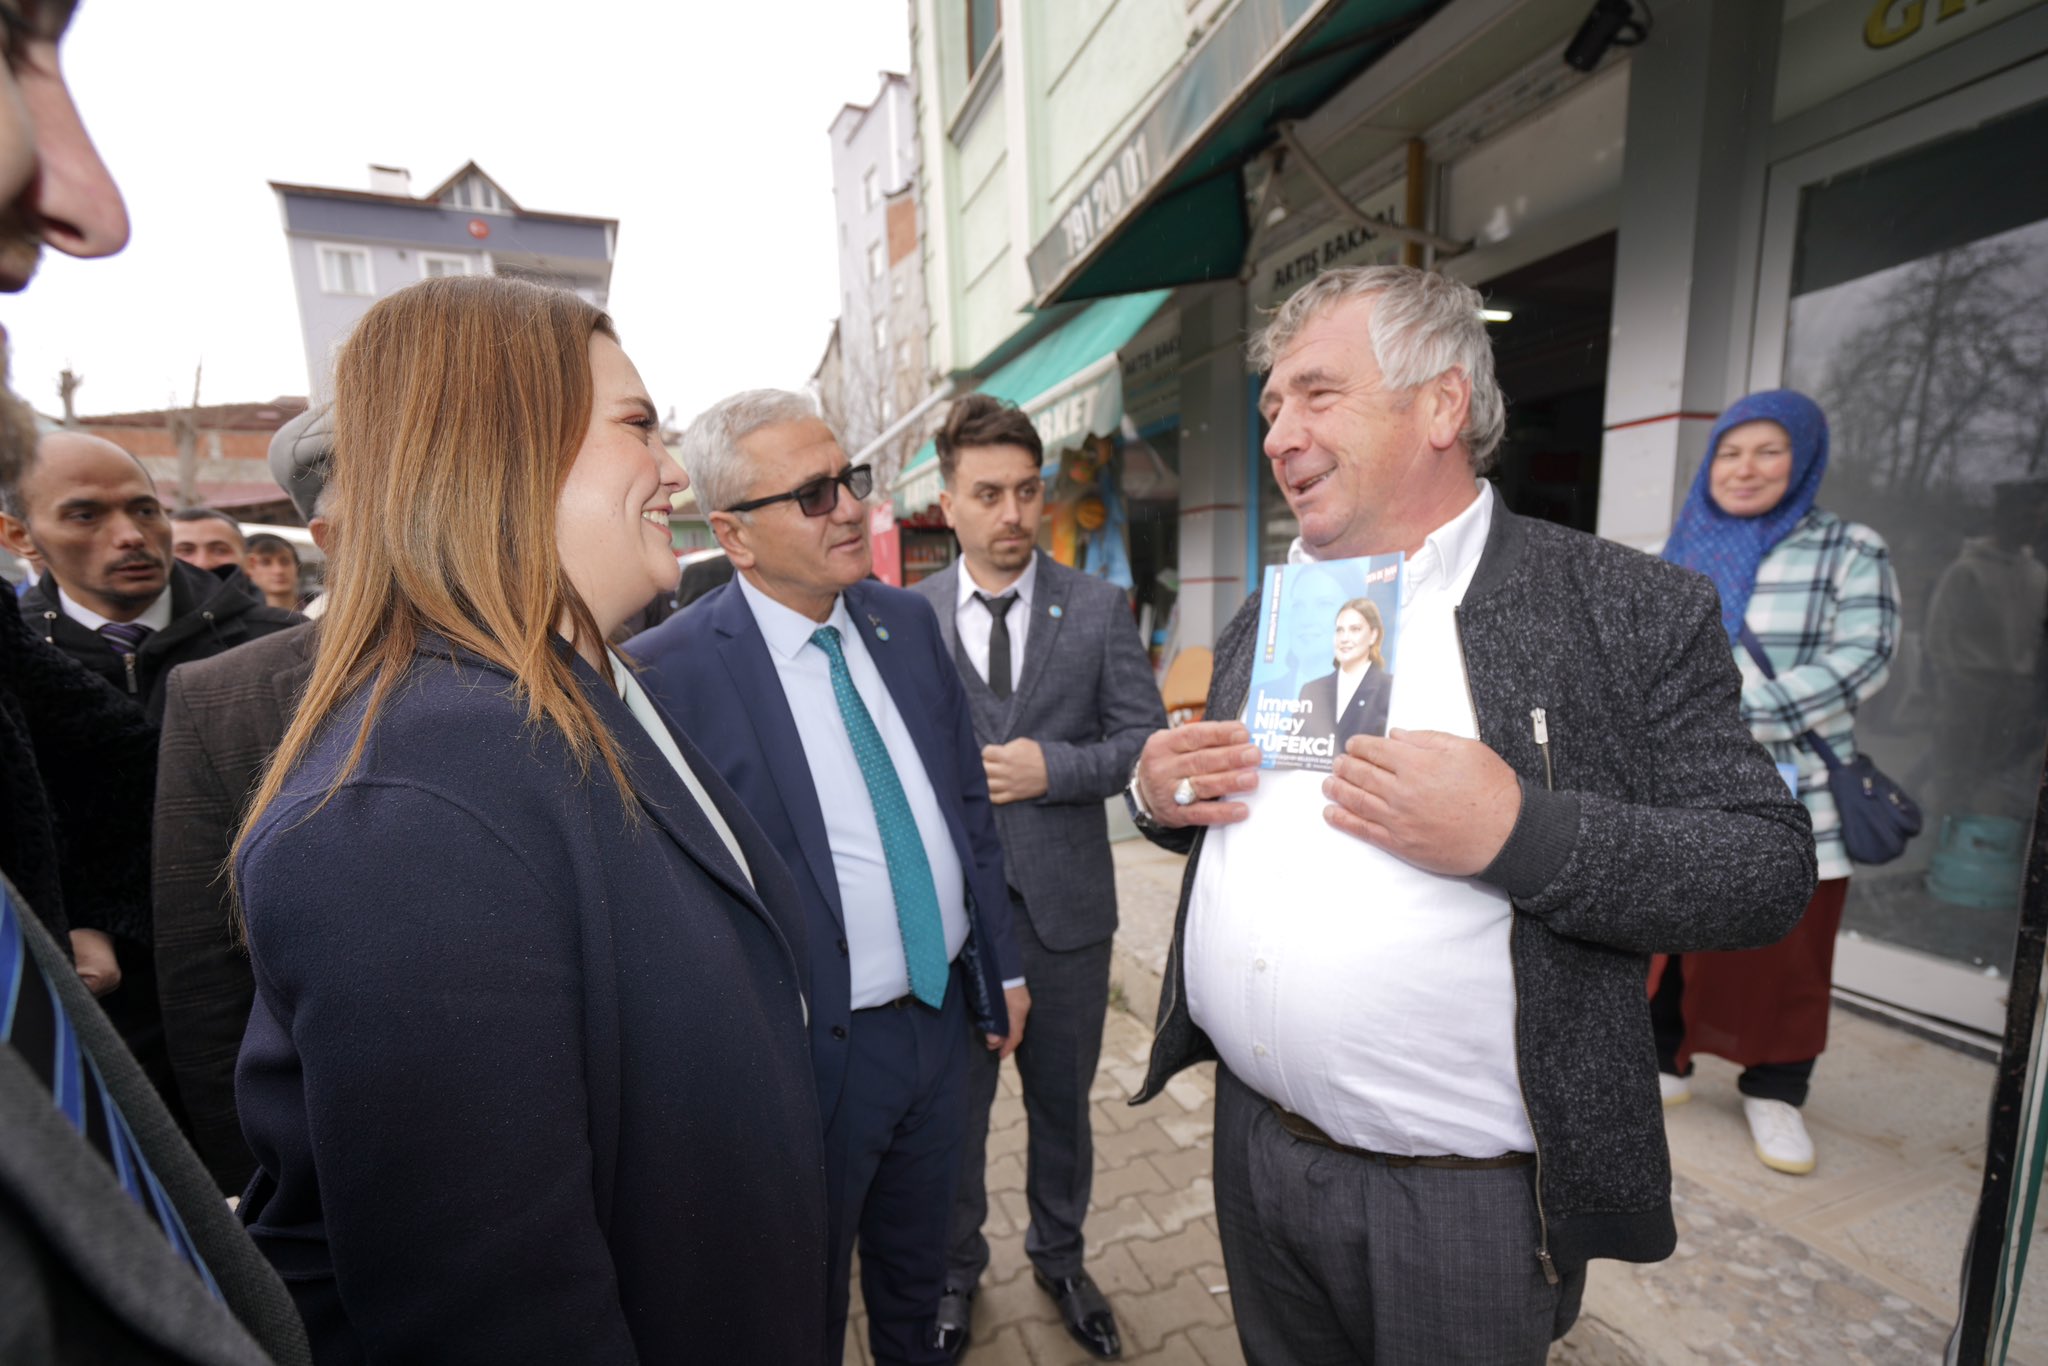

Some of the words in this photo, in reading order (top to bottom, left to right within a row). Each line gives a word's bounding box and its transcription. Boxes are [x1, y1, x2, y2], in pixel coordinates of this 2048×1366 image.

[1060, 193, 1096, 258] 791
[1092, 165, 1121, 230] 20
[1121, 133, 1150, 197] 01
[1254, 711, 1305, 735] Nilay
[1251, 730, 1335, 757] TÜFEKCİ
